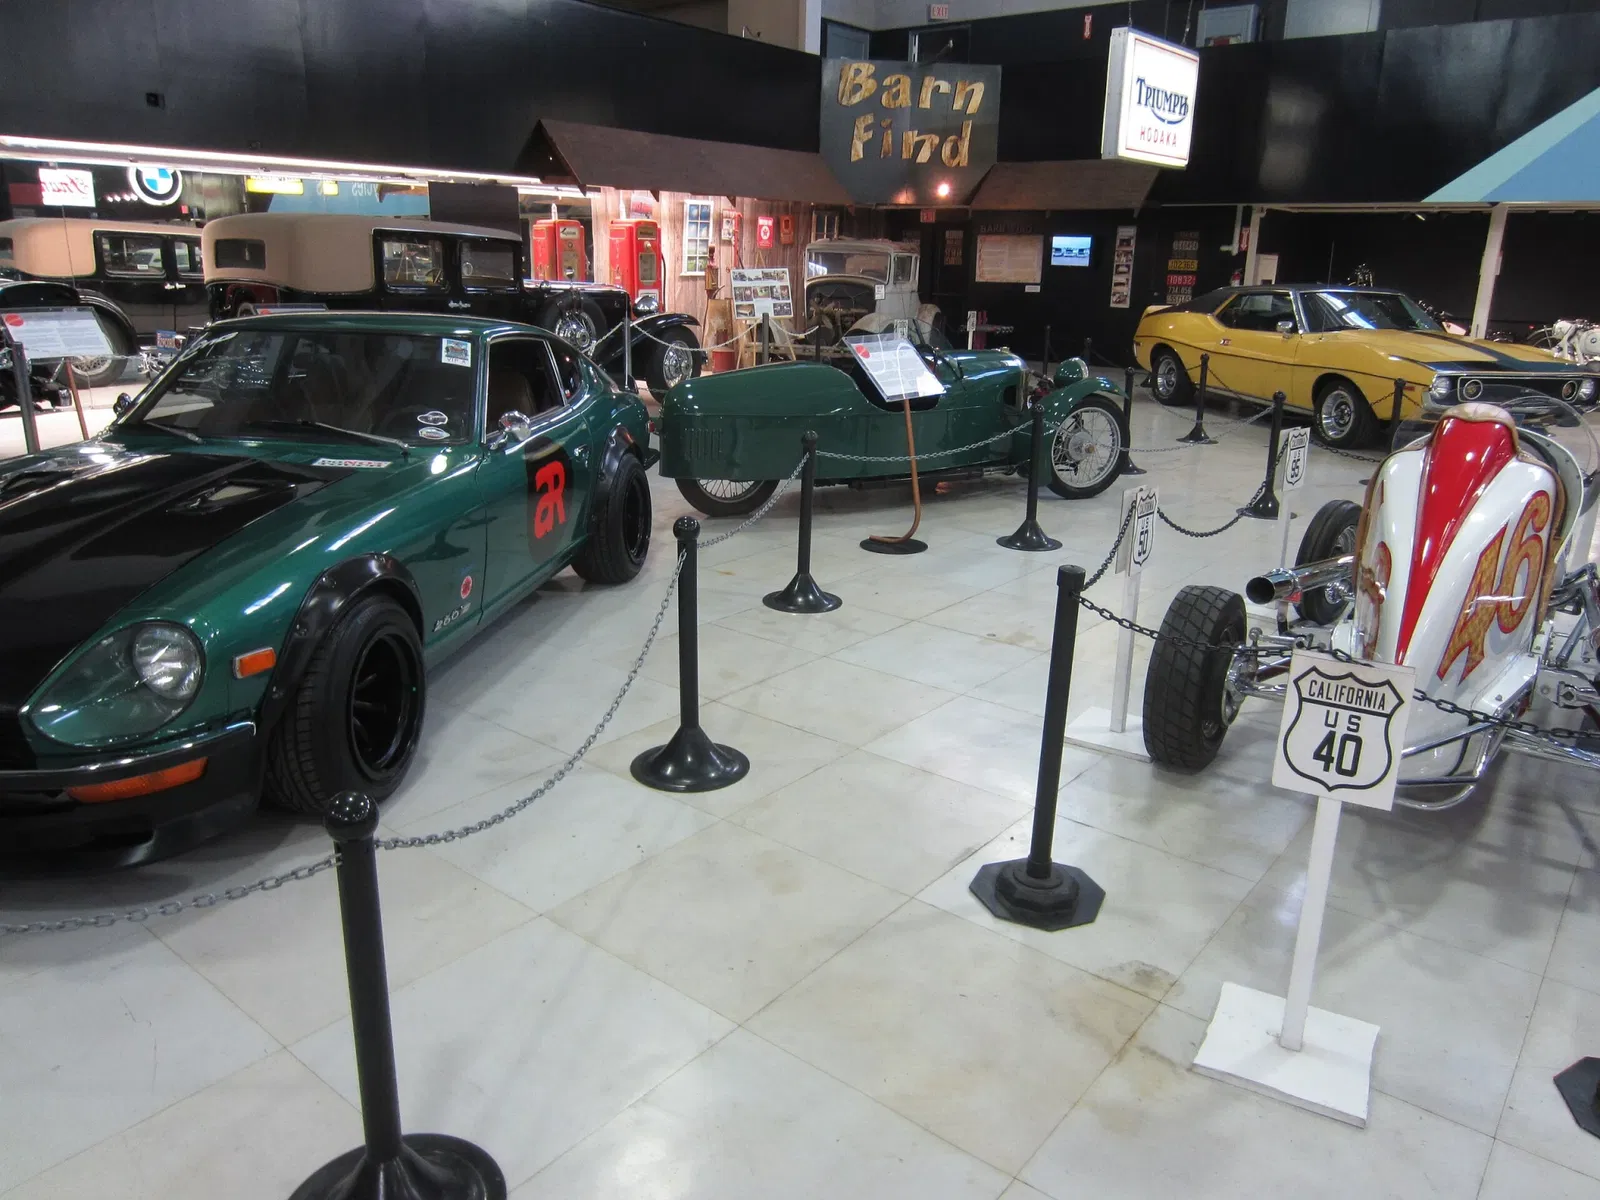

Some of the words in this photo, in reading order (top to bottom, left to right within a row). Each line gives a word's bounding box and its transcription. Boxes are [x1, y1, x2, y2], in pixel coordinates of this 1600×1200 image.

[932, 7, 948, 16] EXIT
[838, 62, 985, 115] Barn
[1136, 77, 1189, 117] TRIUMPH
[850, 113, 973, 168] Find
[1140, 125, 1177, 147] HODAKA
[1290, 459, 1301, 479] 95
[1137, 529, 1149, 557] 50
[1436, 489, 1551, 687] 46
[1308, 679, 1386, 711] CALIFORNIA
[1312, 729, 1363, 778] 40
